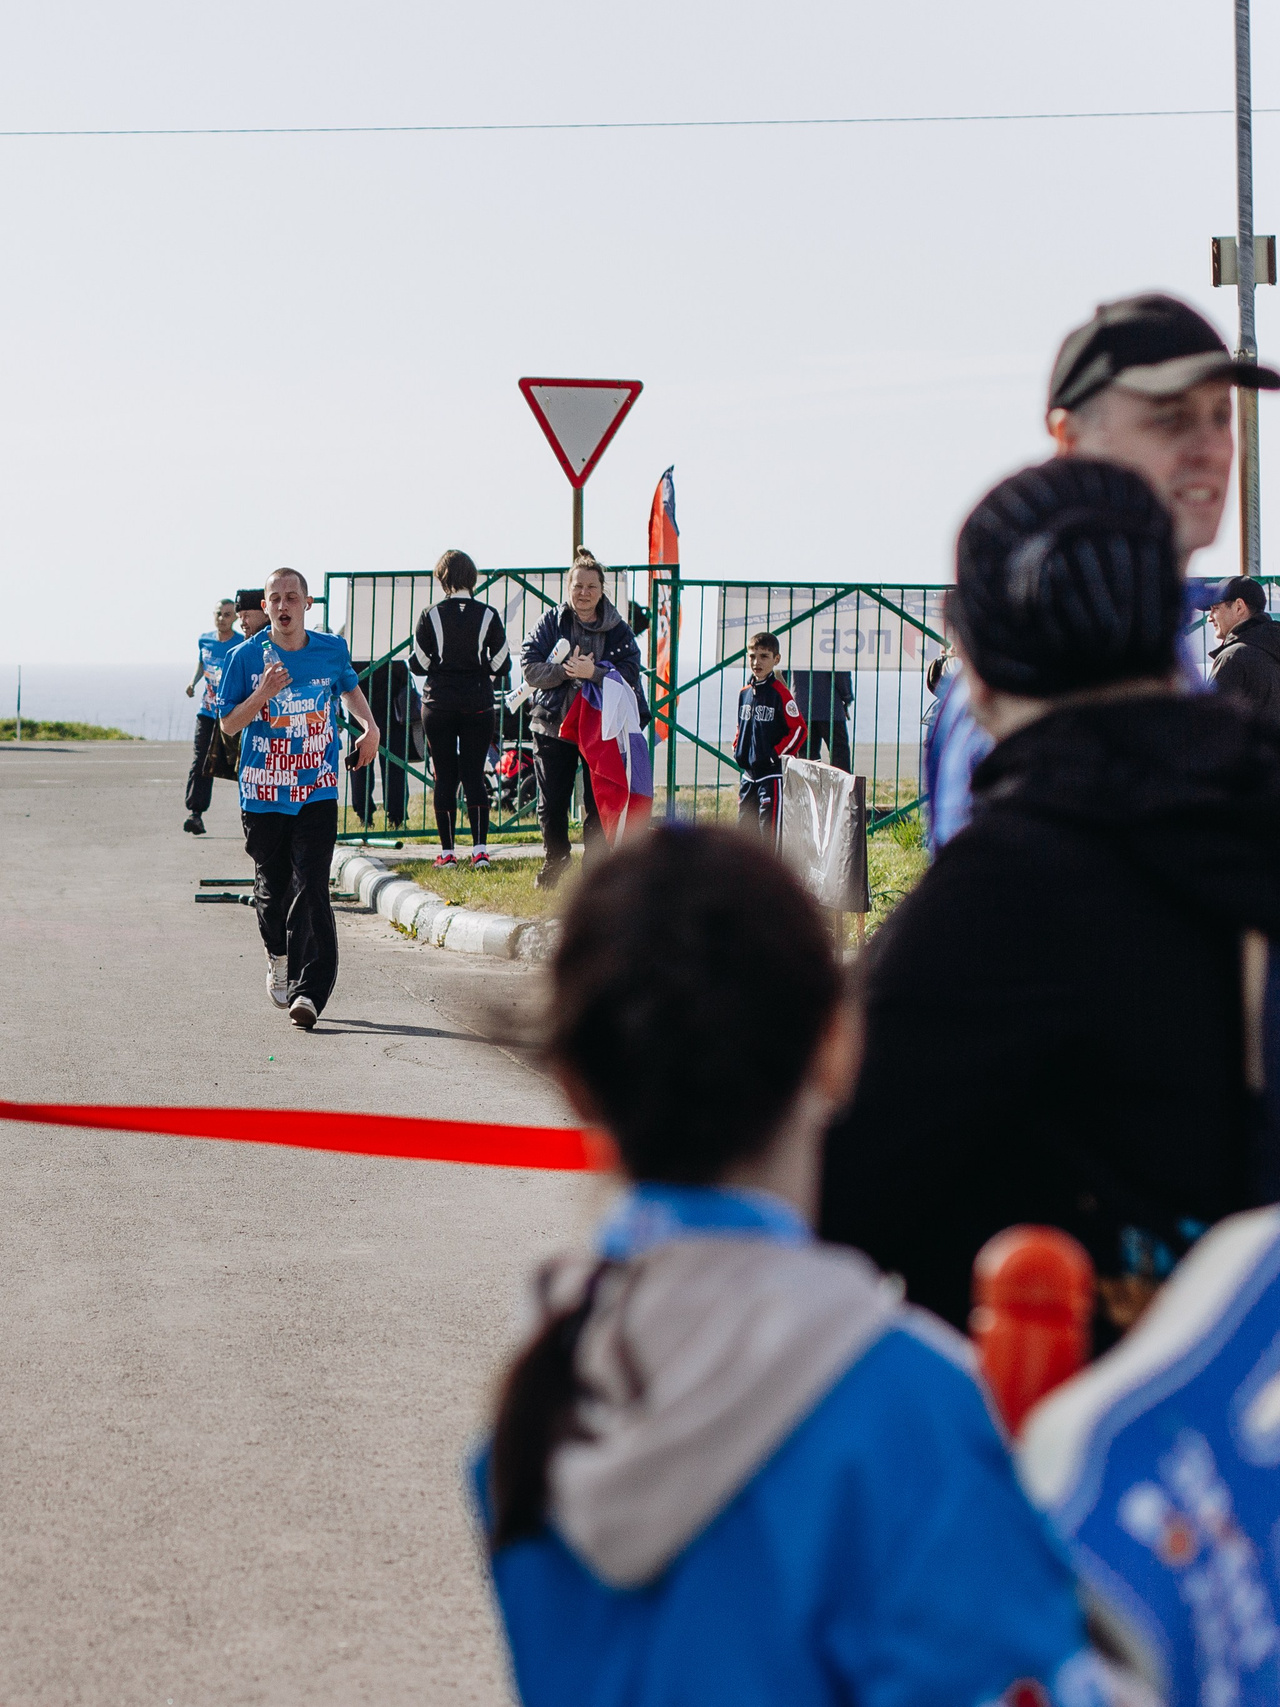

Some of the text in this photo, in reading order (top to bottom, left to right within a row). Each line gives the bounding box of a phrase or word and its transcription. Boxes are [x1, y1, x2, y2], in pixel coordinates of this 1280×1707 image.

[281, 698, 315, 715] 20038
[289, 713, 307, 727] 5КМ
[252, 735, 291, 755] #ЗАБЕГ
